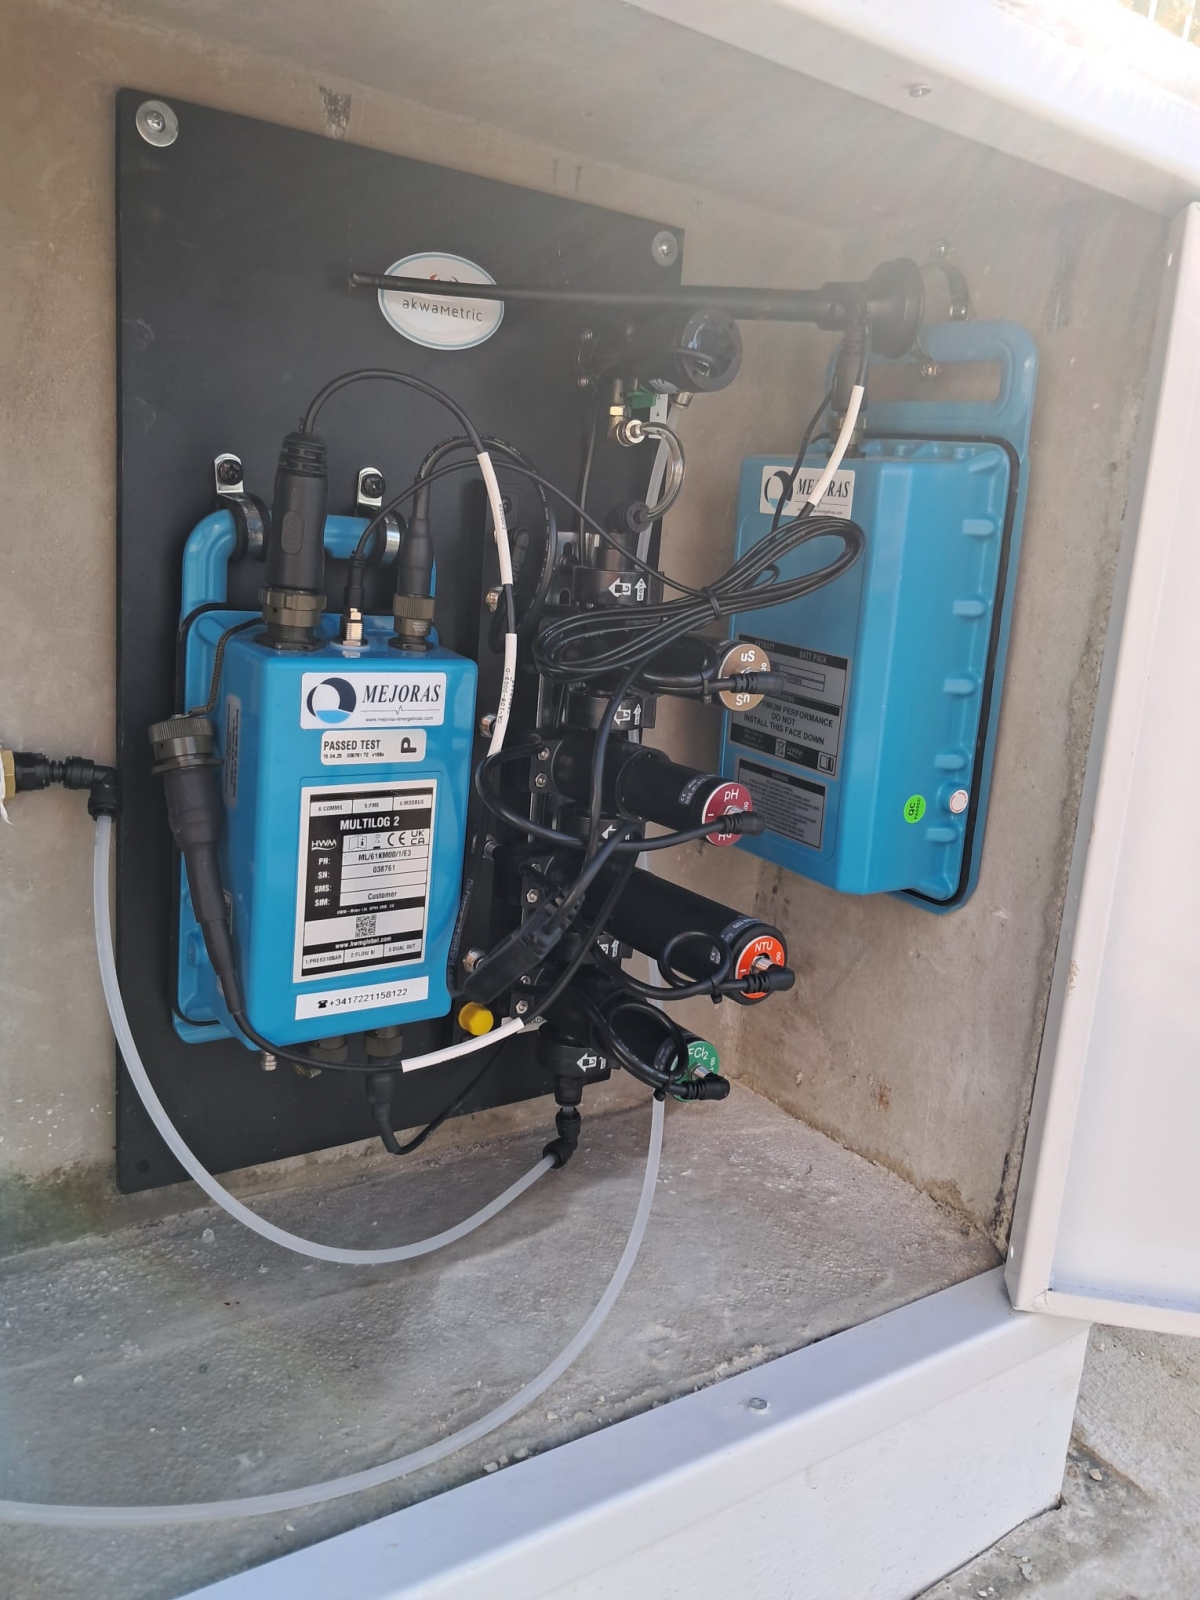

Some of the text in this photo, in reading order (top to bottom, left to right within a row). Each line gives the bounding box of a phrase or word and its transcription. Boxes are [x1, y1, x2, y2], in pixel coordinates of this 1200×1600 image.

[796, 478, 850, 498] MERAS
[740, 650, 756, 662] uS
[361, 684, 441, 703] MEJORAS
[760, 700, 833, 728] TIMUM PERFORMANCE
[771, 713, 796, 726] DO NOT
[743, 714, 768, 728] INSTALL
[769, 721, 783, 732] THIS
[784, 726, 802, 739] FACE
[803, 732, 825, 746] DOWN
[323, 739, 381, 751] PASSED TEST
[724, 788, 739, 803] pH
[908, 802, 916, 816] QC
[340, 815, 400, 831] MULTILOG 2
[387, 832, 406, 846] CE
[410, 829, 425, 837] UK
[311, 839, 337, 848] HWM
[410, 837, 425, 845] CA
[318, 857, 331, 866] PN:
[317, 864, 395, 879] SN: 038761
[314, 885, 332, 893] SMS:
[314, 891, 398, 907] SIM: Customer
[335, 936, 392, 949] www.hwmglobal.com
[754, 941, 773, 952] NTU
[329, 988, 408, 1007] +3417221158122
